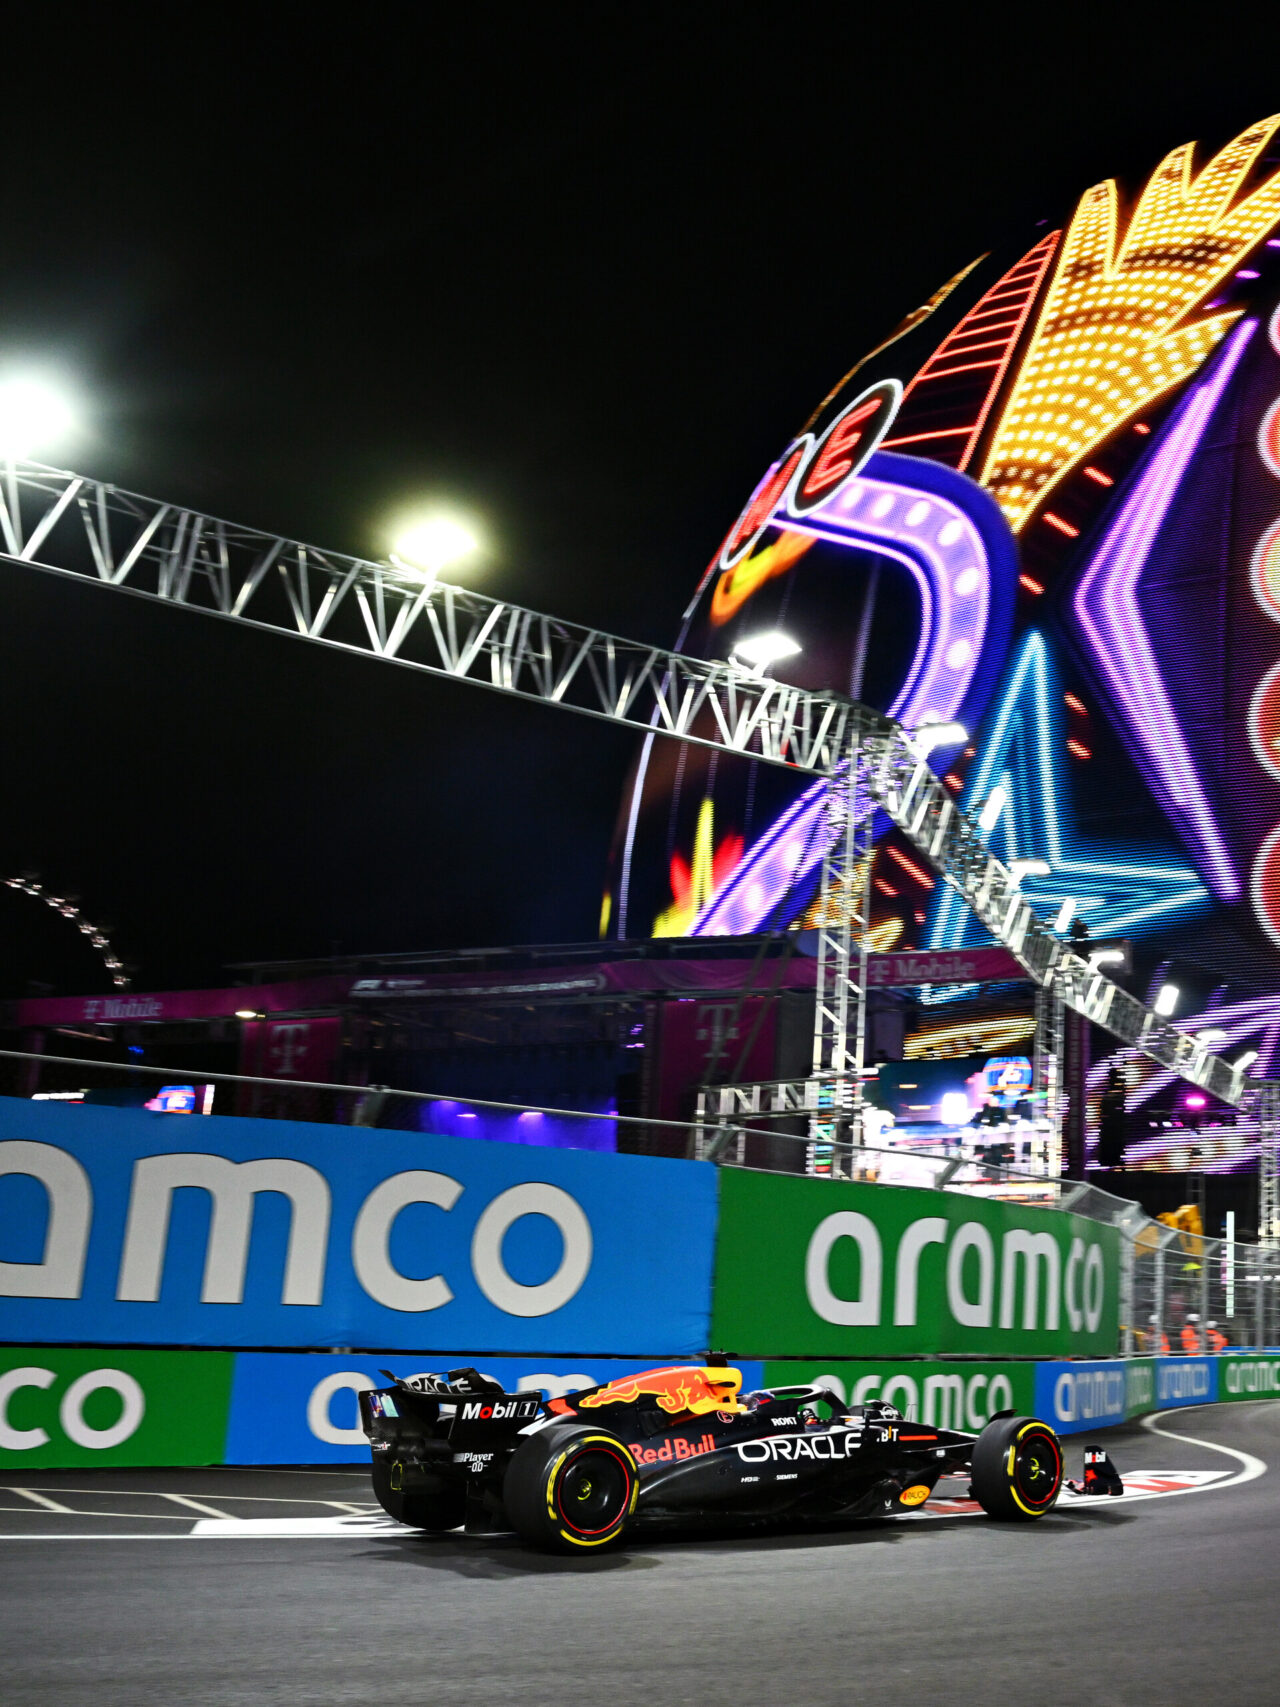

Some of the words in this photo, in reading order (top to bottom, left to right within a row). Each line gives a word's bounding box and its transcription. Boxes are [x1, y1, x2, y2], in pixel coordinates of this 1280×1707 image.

[0, 1139, 593, 1318] amco
[805, 1210, 1101, 1333] aramco
[462, 1402, 518, 1420] Mobil
[463, 1452, 495, 1464] Player
[737, 1432, 862, 1463] ORACLE
